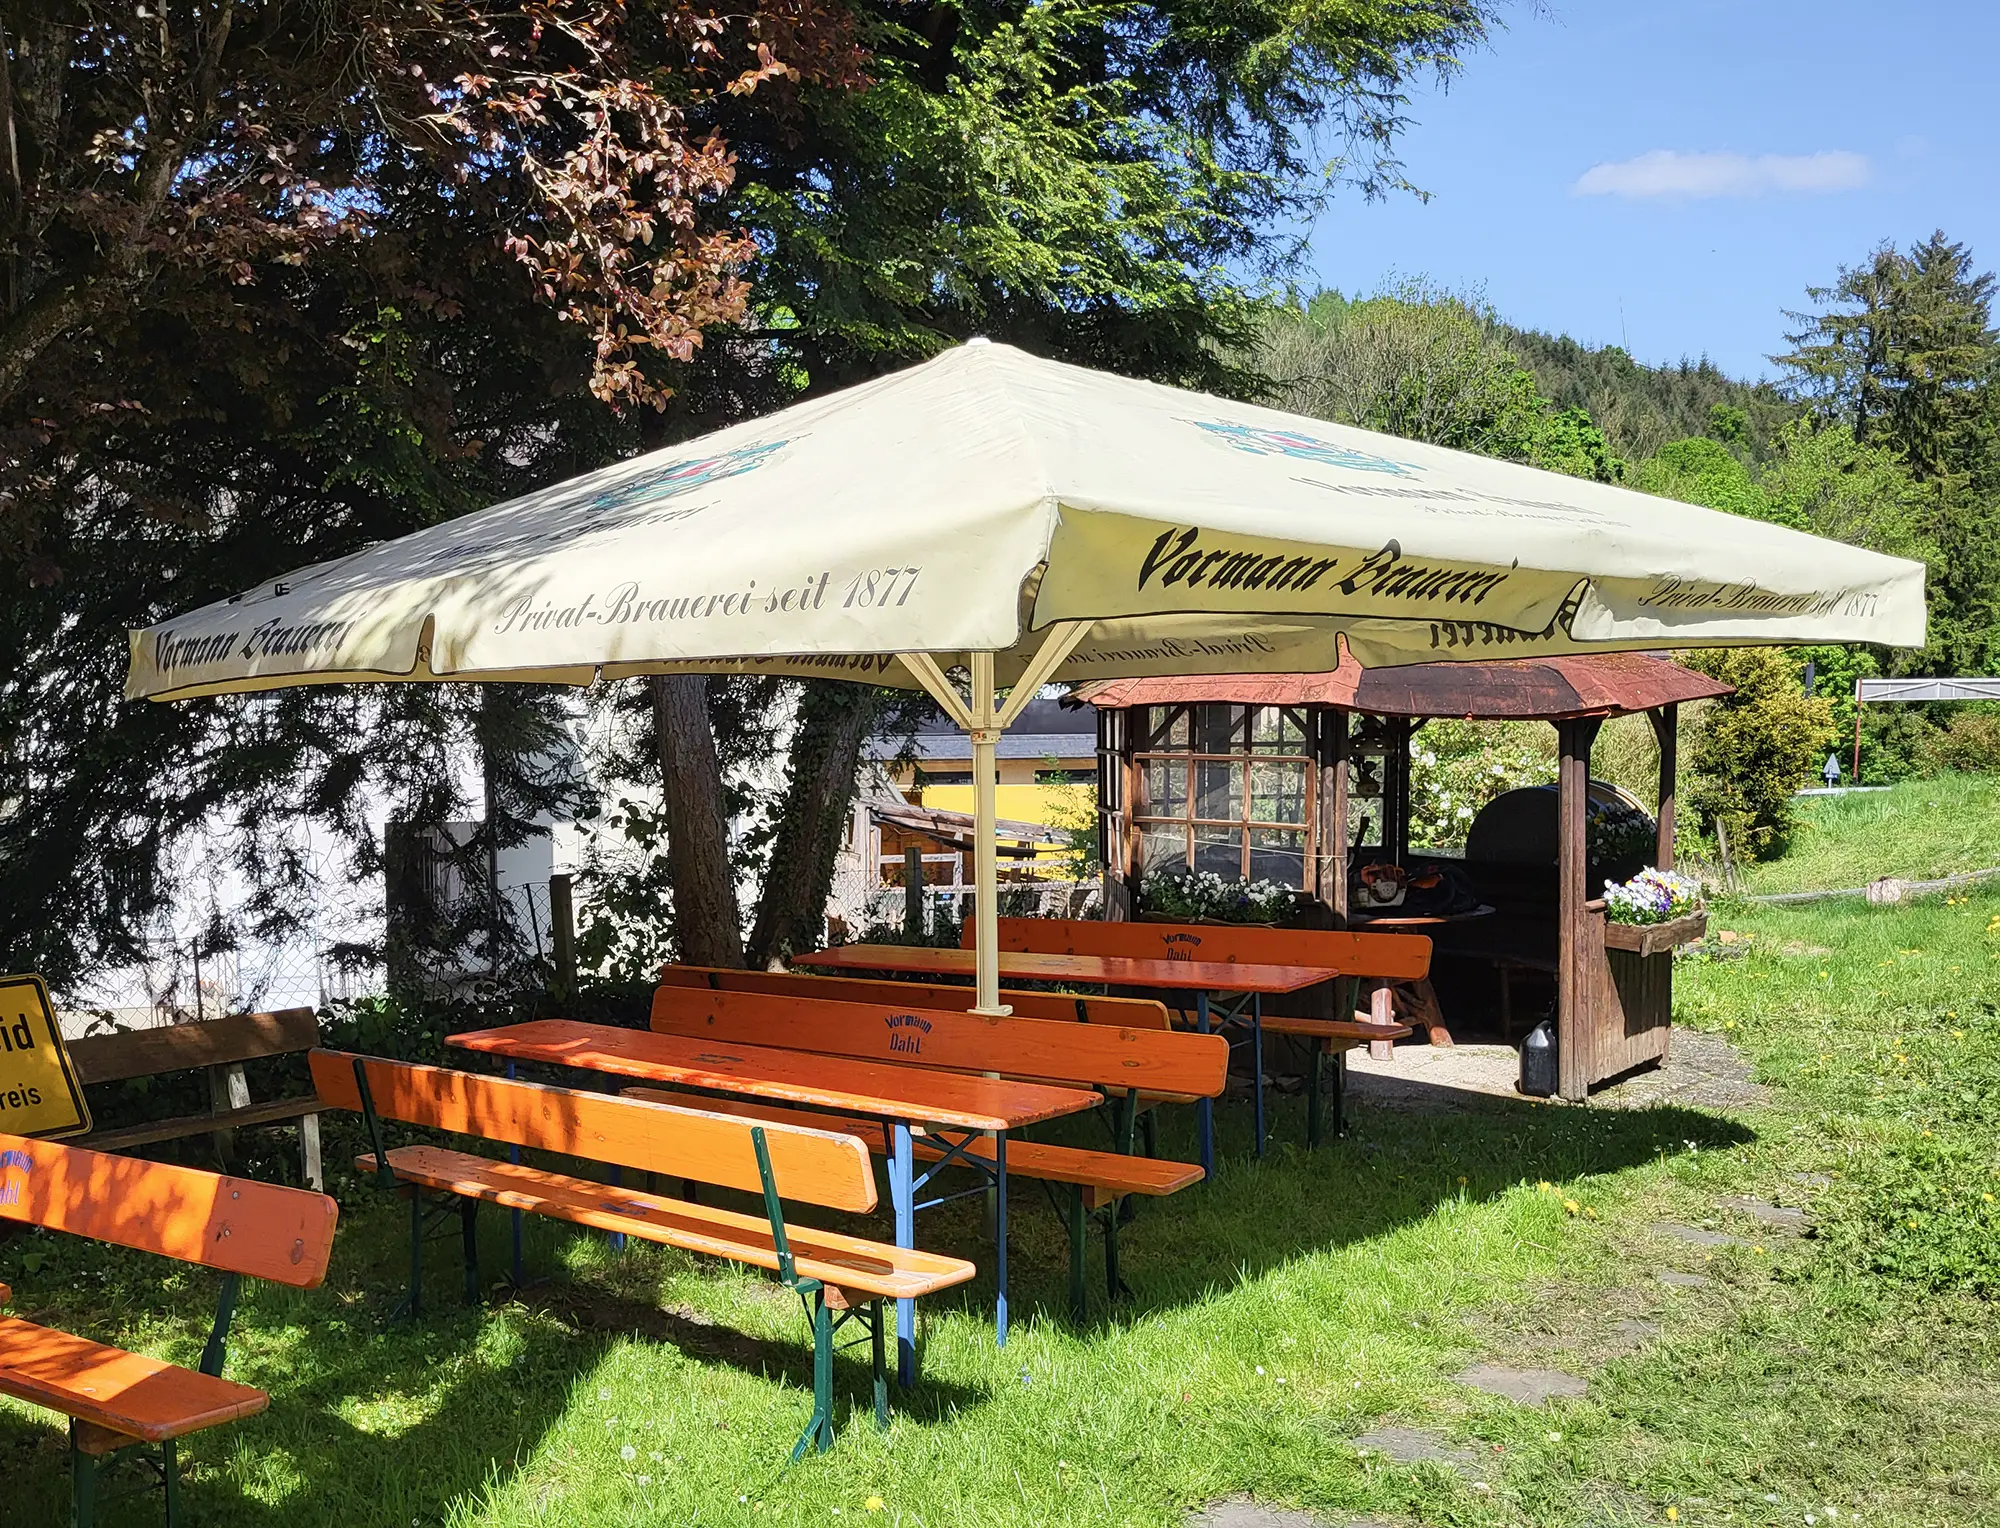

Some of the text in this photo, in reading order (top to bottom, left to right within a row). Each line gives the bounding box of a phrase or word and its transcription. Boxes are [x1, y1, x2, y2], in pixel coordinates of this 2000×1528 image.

[1138, 526, 1519, 604] Vormann Brauerei
[493, 563, 924, 636] Privat-Brauerei seit 1877
[1638, 574, 1817, 613] Privat-Brauerei
[1843, 592, 1879, 618] 1877
[155, 610, 368, 678] Vormann Brauerei
[0, 1013, 35, 1052] id
[889, 1032, 921, 1054] Dahl
